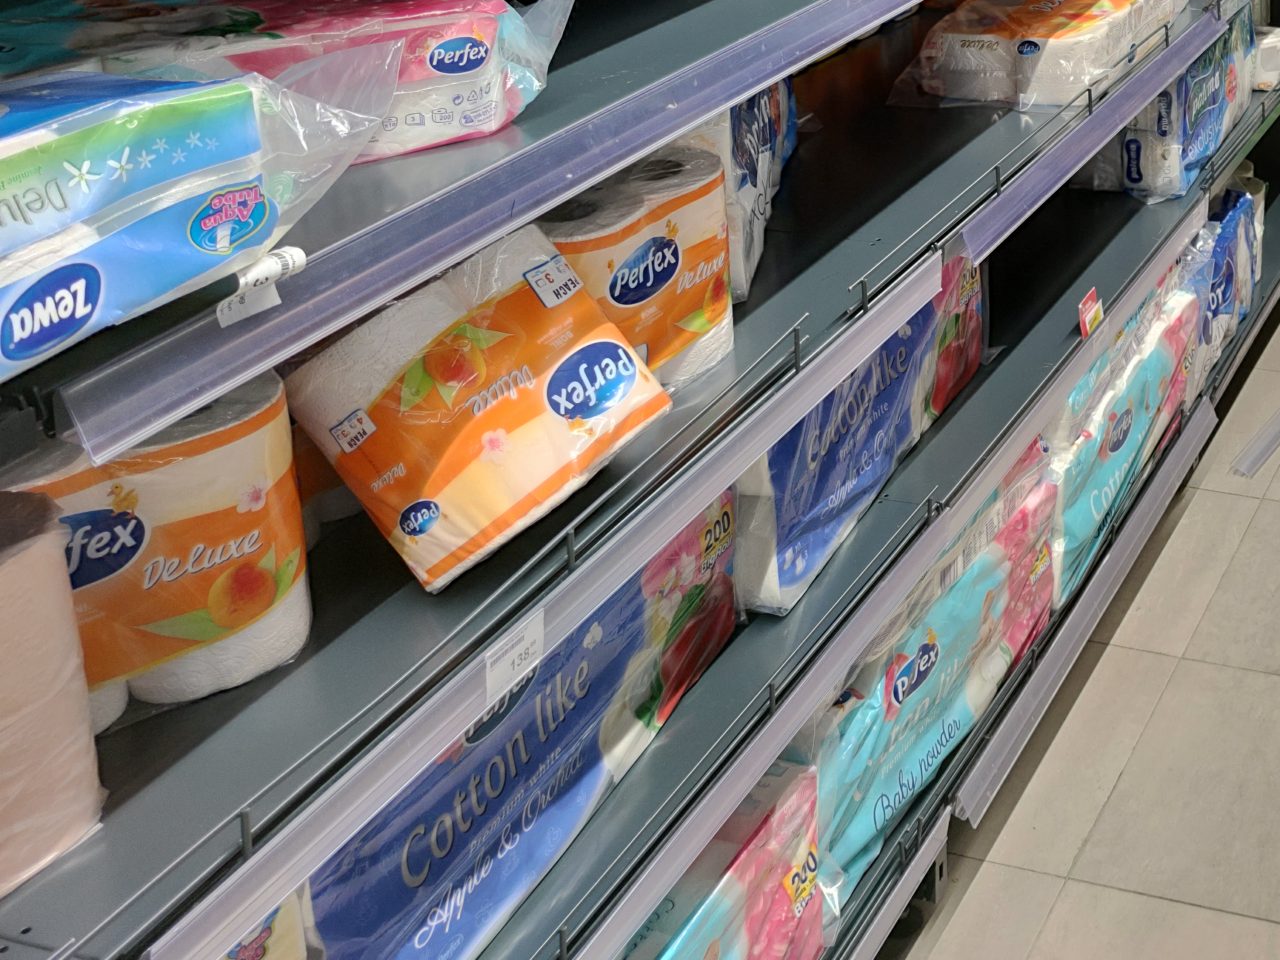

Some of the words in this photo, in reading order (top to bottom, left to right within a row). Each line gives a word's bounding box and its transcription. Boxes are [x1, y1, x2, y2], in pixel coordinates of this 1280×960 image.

[431, 41, 488, 67] Perfex
[1191, 71, 1220, 122] paloma
[200, 205, 252, 231] Aqua
[211, 184, 266, 210] Tube
[544, 272, 554, 283] 3
[552, 276, 579, 301] PEACH
[613, 241, 677, 297] Perfex
[676, 251, 726, 294] Deluxe
[9, 278, 93, 345] Zewa
[552, 348, 636, 415] Perfex
[872, 343, 907, 389] like
[465, 364, 537, 418] Deluxe
[346, 426, 368, 450] PEACH
[355, 417, 363, 428] 4
[370, 462, 406, 493] Deluxe
[401, 502, 439, 533] Perfex
[704, 509, 731, 552] 200
[66, 518, 137, 575] fex
[143, 528, 265, 591] Deluxe
[509, 646, 530, 672] 138
[895, 647, 940, 701] Pfex
[401, 727, 532, 888] Cotton
[536, 660, 590, 744] like
[872, 769, 918, 832] Baby
[918, 716, 962, 781] powder
[415, 855, 494, 949] Apple
[496, 824, 520, 856] &
[789, 850, 818, 892] 200
